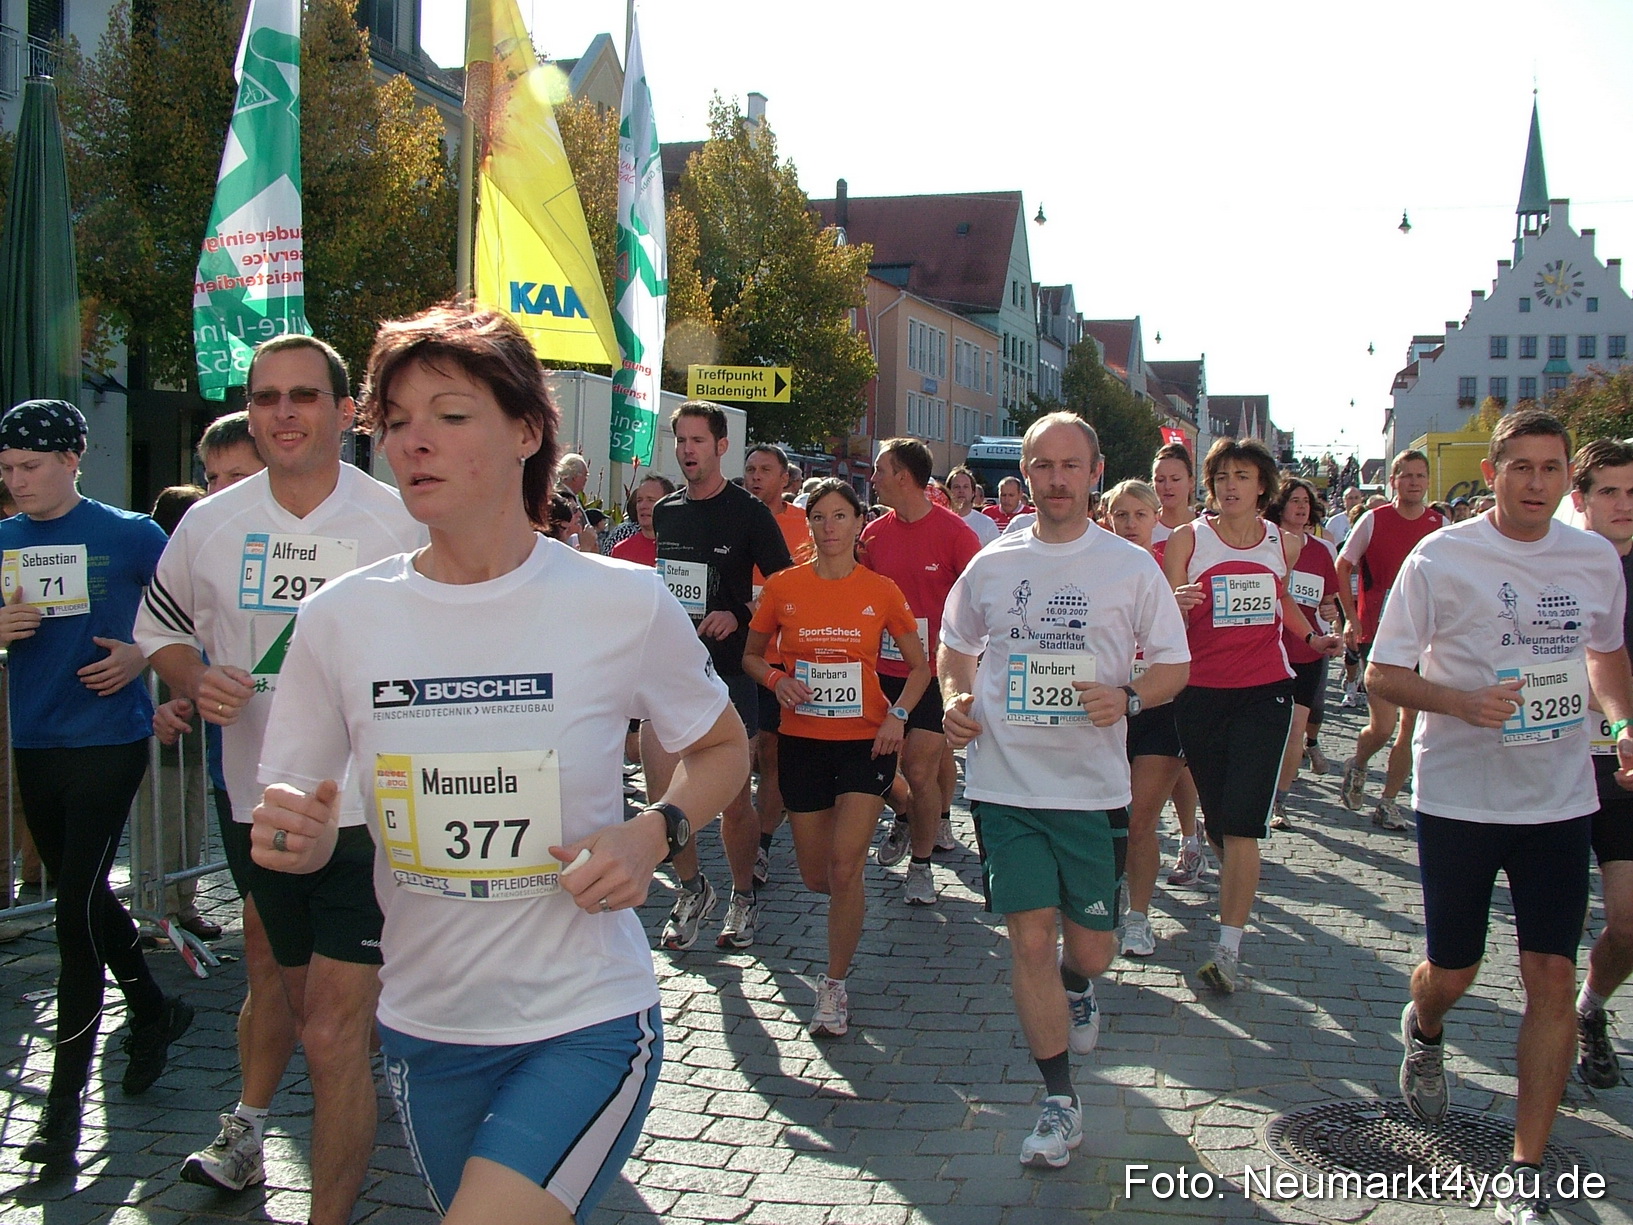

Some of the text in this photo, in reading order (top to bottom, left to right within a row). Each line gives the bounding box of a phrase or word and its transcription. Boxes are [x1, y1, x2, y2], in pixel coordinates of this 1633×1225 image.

[696, 368, 763, 383] Treffpunkt
[696, 384, 768, 399] Bladenight
[610, 410, 648, 433] ine:
[609, 432, 633, 451] 52
[272, 541, 317, 561] Alfred
[22, 552, 77, 567] Sebastian
[246, 567, 253, 580] C
[666, 565, 690, 577] Stefan
[4, 576, 11, 587] C
[39, 577, 64, 597] 71
[1229, 580, 1260, 591] Brigitte
[668, 583, 702, 599] 2889
[1295, 584, 1320, 598] 3581
[1046, 607, 1088, 616] 16.09.2007
[1232, 597, 1271, 611] 2525
[798, 626, 861, 637] SportScheck
[1010, 627, 1086, 642] 8. Neumarkter
[1039, 640, 1086, 650] Stadtlauf
[1501, 633, 1580, 646] 8. Neumarkter
[811, 667, 848, 680] Barbara
[1030, 660, 1076, 675] Norbert
[1010, 681, 1017, 691] C
[1525, 671, 1568, 688] Thomas
[424, 678, 547, 701] BÜSCHEL
[813, 687, 857, 703] 2120
[373, 704, 555, 721] FEINSCHNEIDTECHNIK WERKZEUGBAU
[1530, 693, 1582, 722] 3289
[422, 767, 518, 795] Manuela
[385, 810, 397, 829] C
[444, 819, 531, 860] 377
[490, 873, 559, 891] PFLEIDERER
